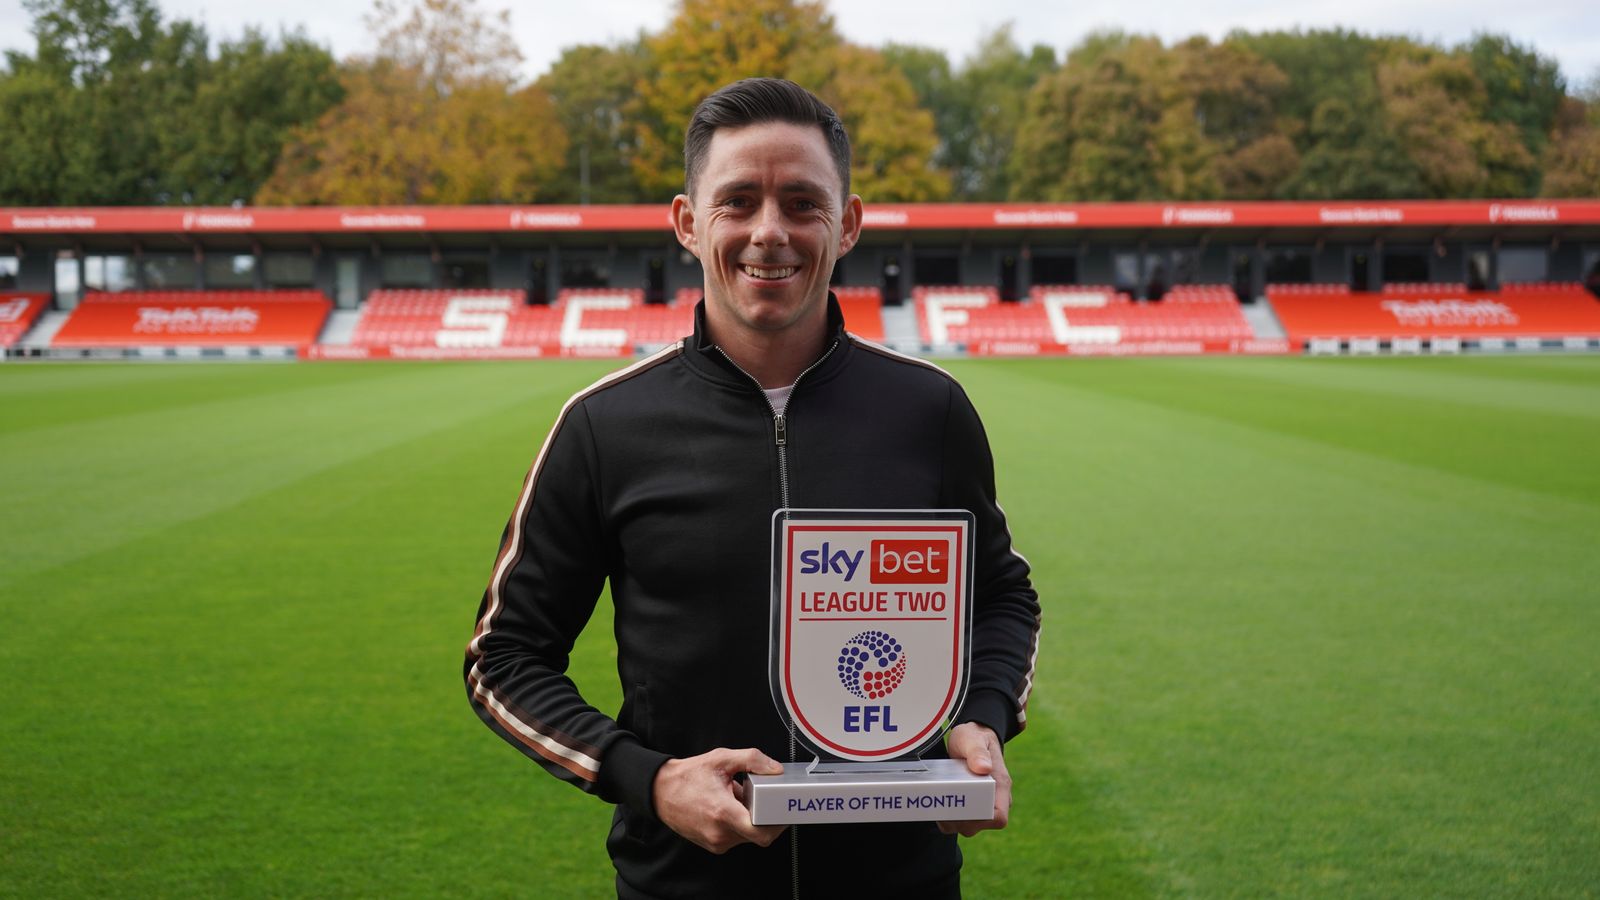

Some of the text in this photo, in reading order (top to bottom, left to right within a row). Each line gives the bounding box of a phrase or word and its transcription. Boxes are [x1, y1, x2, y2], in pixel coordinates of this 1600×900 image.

[435, 293, 1121, 348] S C F C
[800, 541, 941, 582] sky bet
[800, 591, 946, 613] LEAGUE TWO
[843, 705, 898, 733] EFL
[788, 795, 966, 811] PLAYER OF THE MONTH
